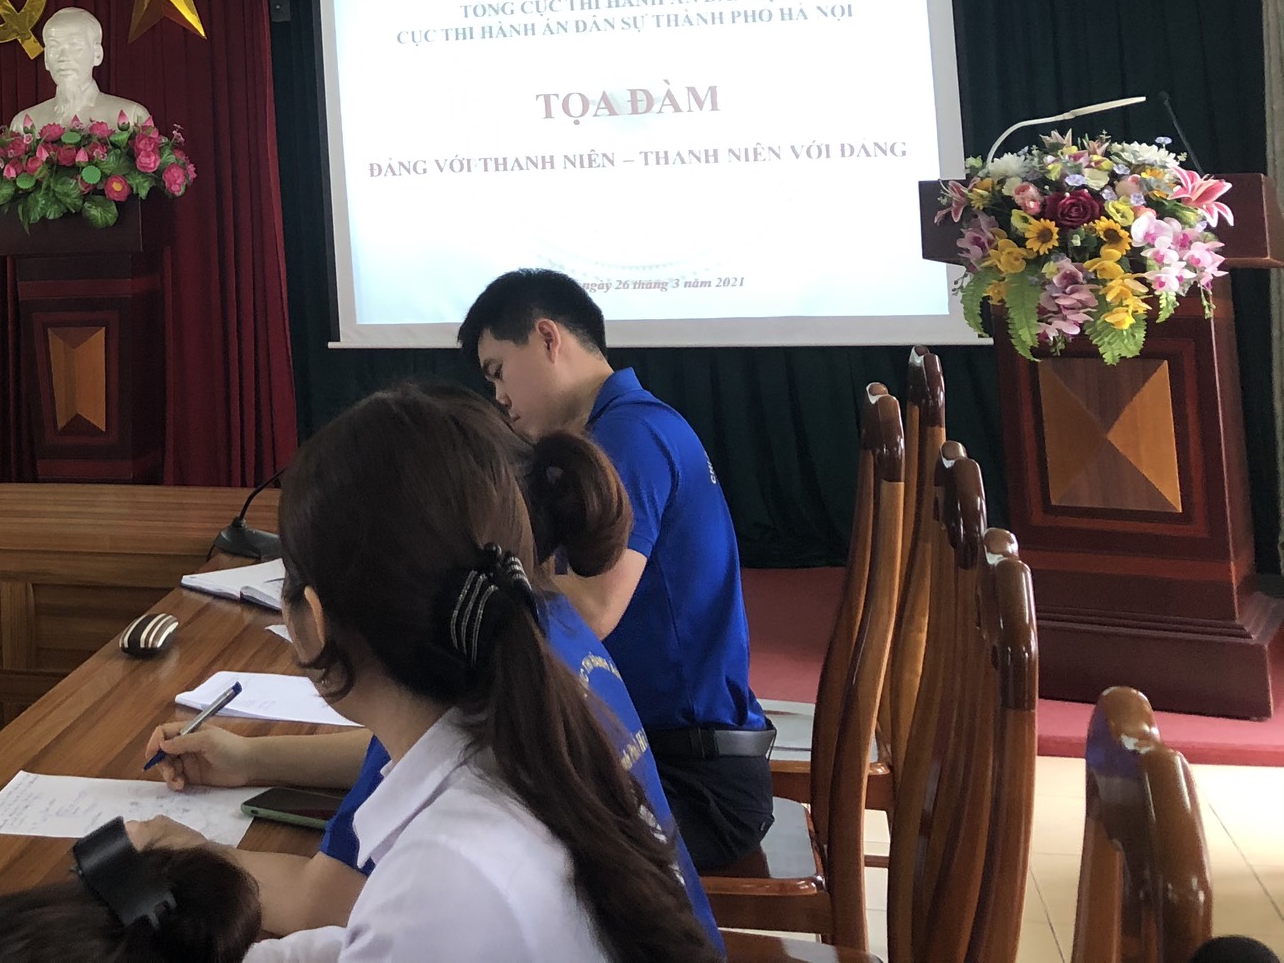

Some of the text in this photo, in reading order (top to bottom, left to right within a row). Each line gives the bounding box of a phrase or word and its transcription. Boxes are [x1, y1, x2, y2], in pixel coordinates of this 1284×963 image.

[396, 29, 437, 47] CỤC
[441, 26, 475, 41] THI
[481, 21, 536, 39] HÀNH
[542, 18, 569, 36] ÁN
[575, 14, 616, 33] DÂN
[620, 13, 648, 32] SỰ
[652, 9, 724, 28] THÀNH
[536, 79, 721, 126] TỌA ĐÀM
[434, 154, 473, 174] VỚI
[479, 154, 556, 173] THANH
[563, 149, 615, 169] NIÊN
[639, 147, 719, 166] THANH
[728, 142, 781, 163] NIÊN
[790, 140, 831, 160] VỚI
[582, 276, 745, 293] ngày 26 tháng 3 năm 2021
